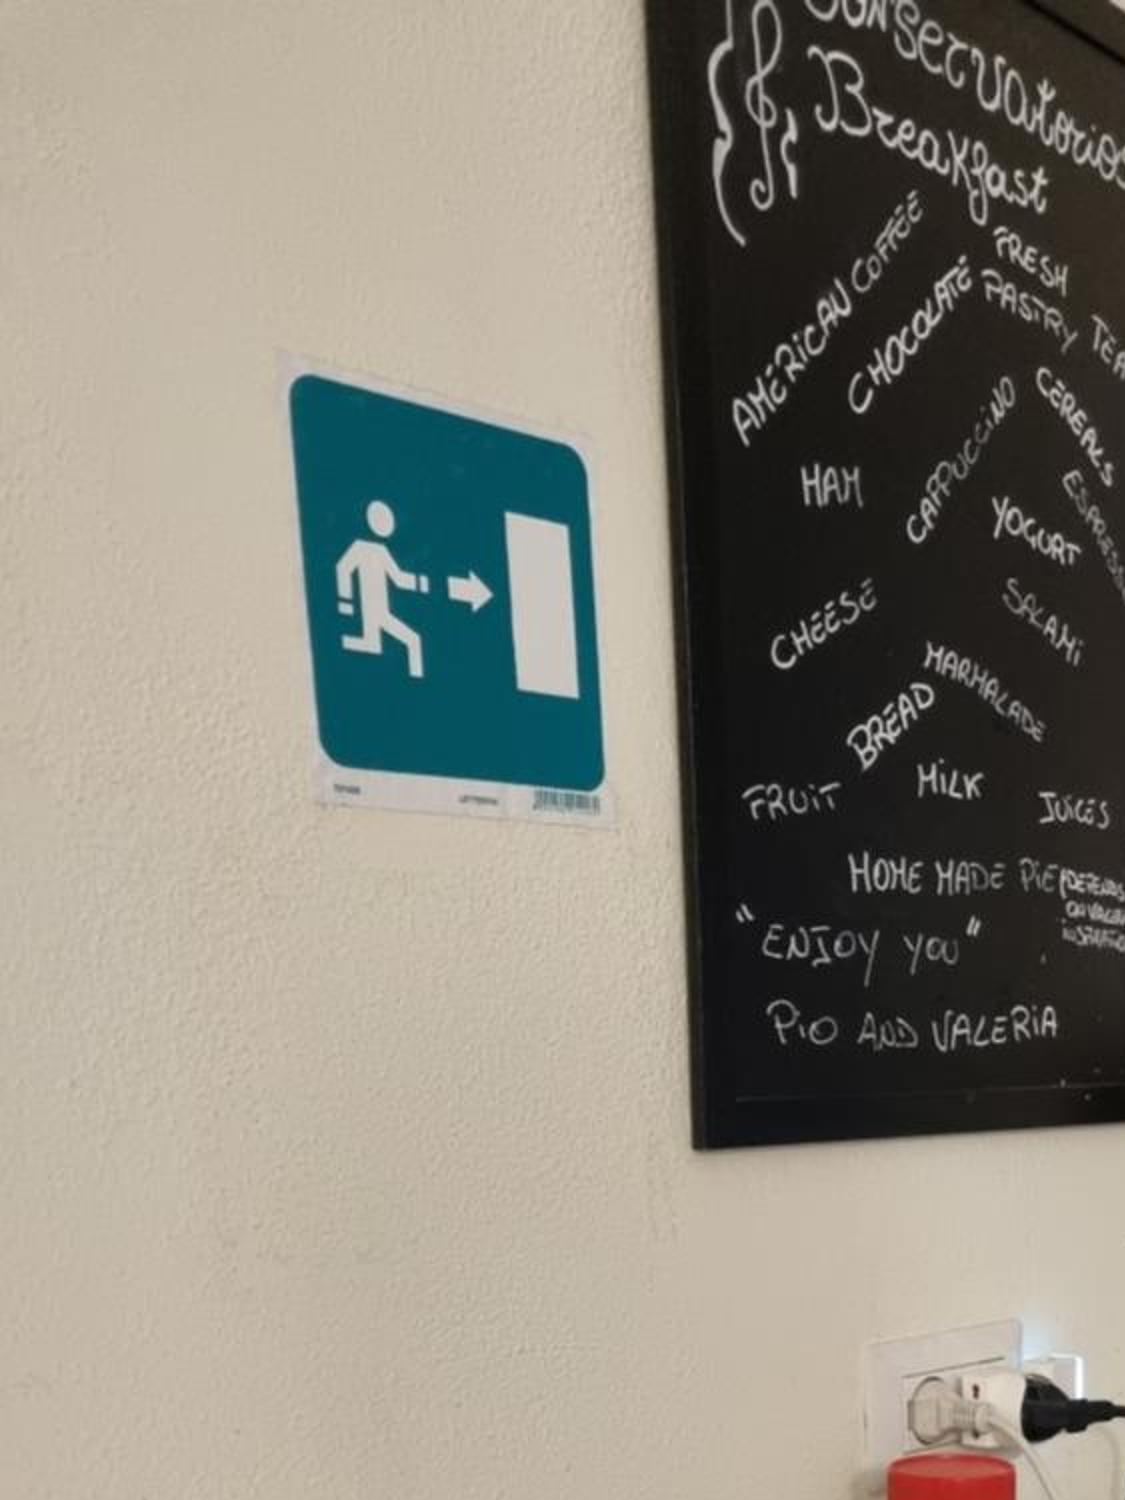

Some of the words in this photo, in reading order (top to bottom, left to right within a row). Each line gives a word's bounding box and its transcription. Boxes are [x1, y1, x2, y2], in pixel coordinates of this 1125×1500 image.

[851, 190, 923, 293] COFFEE
[993, 226, 1069, 297] FRESH
[848, 255, 972, 414] CHOCOLATE
[981, 269, 1078, 353] PASTRY
[906, 376, 1017, 543] CAPPUCCINO
[1036, 366, 1115, 487] CEREALS
[801, 463, 863, 508] HAM
[991, 496, 1082, 566] YOGURT
[770, 579, 878, 670] CHEESE
[1002, 577, 1085, 668] SALAMI
[846, 682, 936, 772] BREAD
[923, 640, 1045, 743] MARMALADE
[742, 781, 843, 821] FRUIT
[917, 758, 986, 800] MILK
[1038, 791, 1110, 828] JUICES
[847, 851, 924, 894] HOME
[935, 859, 1005, 896] MADE
[1018, 857, 1059, 893] PIE
[767, 1000, 838, 1046] PIO
[857, 1011, 918, 1051] AND
[931, 1005, 1058, 1052] VALERIA
